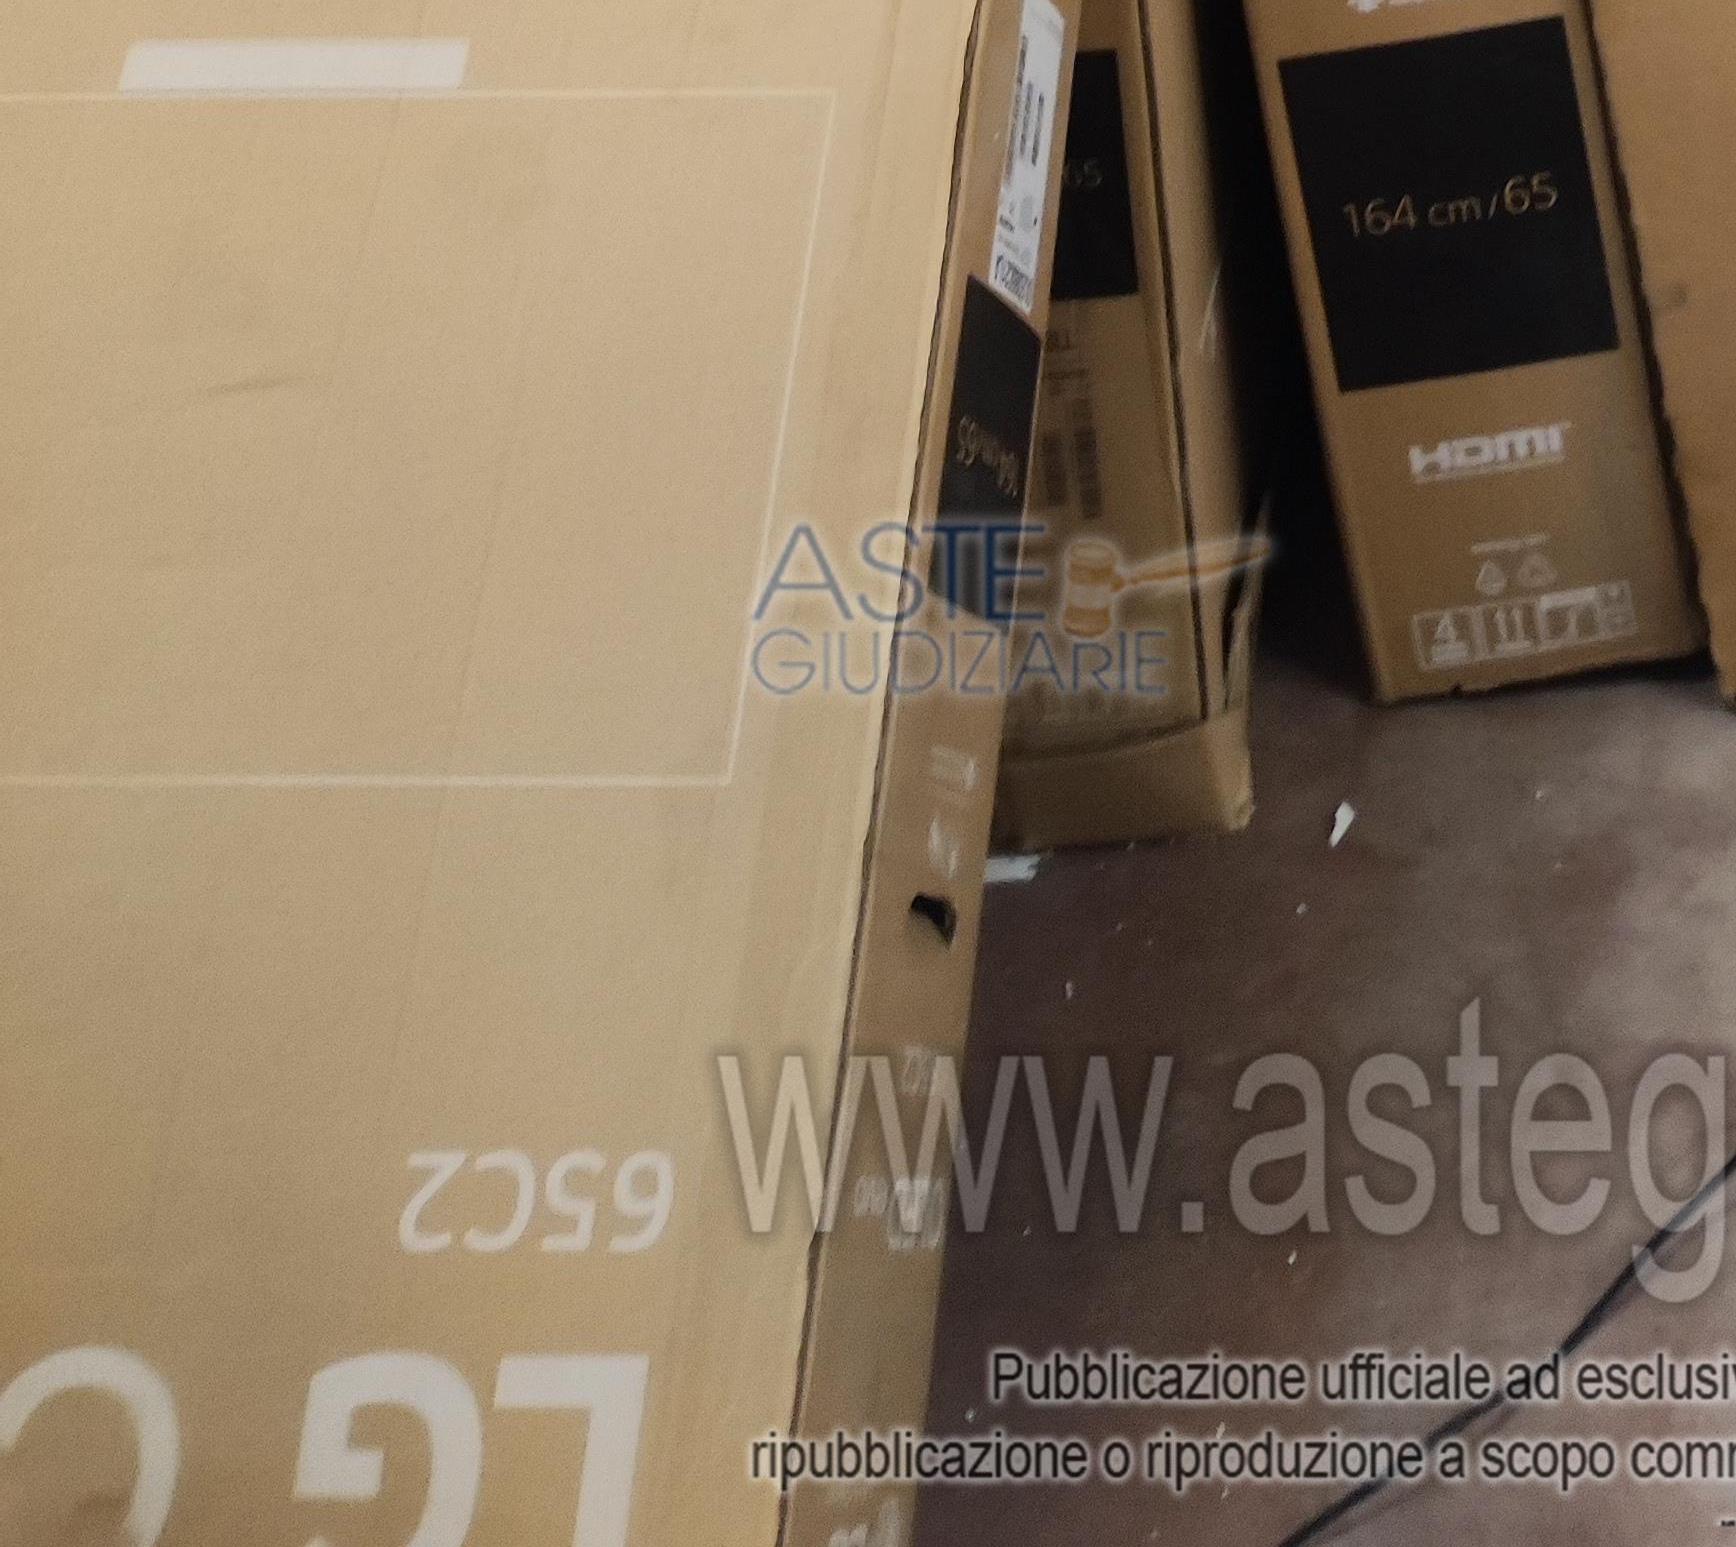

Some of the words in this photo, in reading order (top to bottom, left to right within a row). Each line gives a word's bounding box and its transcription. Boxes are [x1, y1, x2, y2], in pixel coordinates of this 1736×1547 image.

[1344, 192, 1417, 238] 164
[1408, 424, 1565, 475] HDMI
[399, 1150, 676, 1253] 65C2
